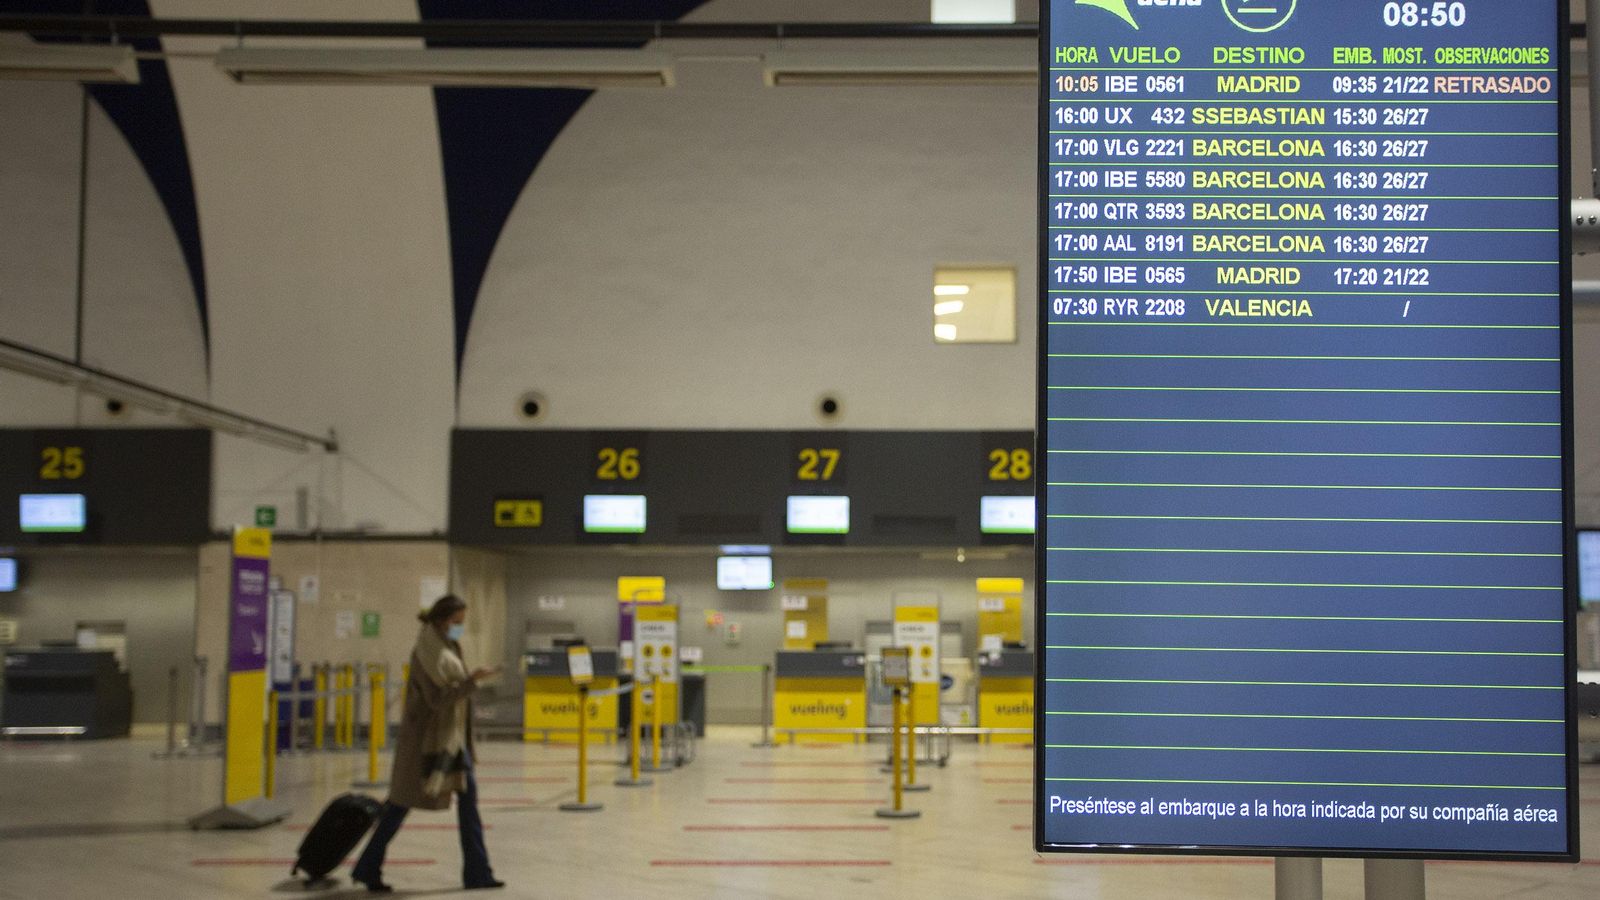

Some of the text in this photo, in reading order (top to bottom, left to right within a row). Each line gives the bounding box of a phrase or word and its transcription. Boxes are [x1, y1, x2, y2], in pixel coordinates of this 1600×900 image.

[1383, 2, 1466, 27] 08:50
[1055, 46, 1550, 65] HORA VUELO DESTINO EMB. MOST. OBSERVACIONES
[1055, 75, 1551, 94] 10:05 IBE 0561 MADRID 09:35 21/22 RETRASADO
[1055, 106, 1429, 126] 16:00 UX 432 SSEBASTIAN 15:30 26/27
[1054, 138, 1429, 158] 17:00 VLG 2221 BARCELONA 16:30 26/27
[1054, 170, 1429, 190] 17:00 IBE 5580 BARCELONA 16:30 26/27
[1054, 202, 1429, 222] 17:00 QTR 3593 BARCELONA 16:30 26/27
[1054, 233, 1429, 254] 17:00 AAL 8191 BARCELONA 16:30 26/27
[1054, 265, 1430, 286] 17:50 IBE 0565 MADRID 17:20 21/22
[1053, 297, 1098, 315] 07:30
[1103, 298, 1139, 316] RYR
[1144, 298, 1186, 316] 2208
[1204, 298, 1314, 317] VALENCIA
[40, 446, 85, 480] 25
[597, 448, 640, 480] 26
[798, 449, 841, 481] 27
[989, 448, 1032, 480] 28
[790, 699, 847, 719] vueling
[1050, 795, 1559, 825] Preséntese al embarque a la hora indicada por su compañía aérea
